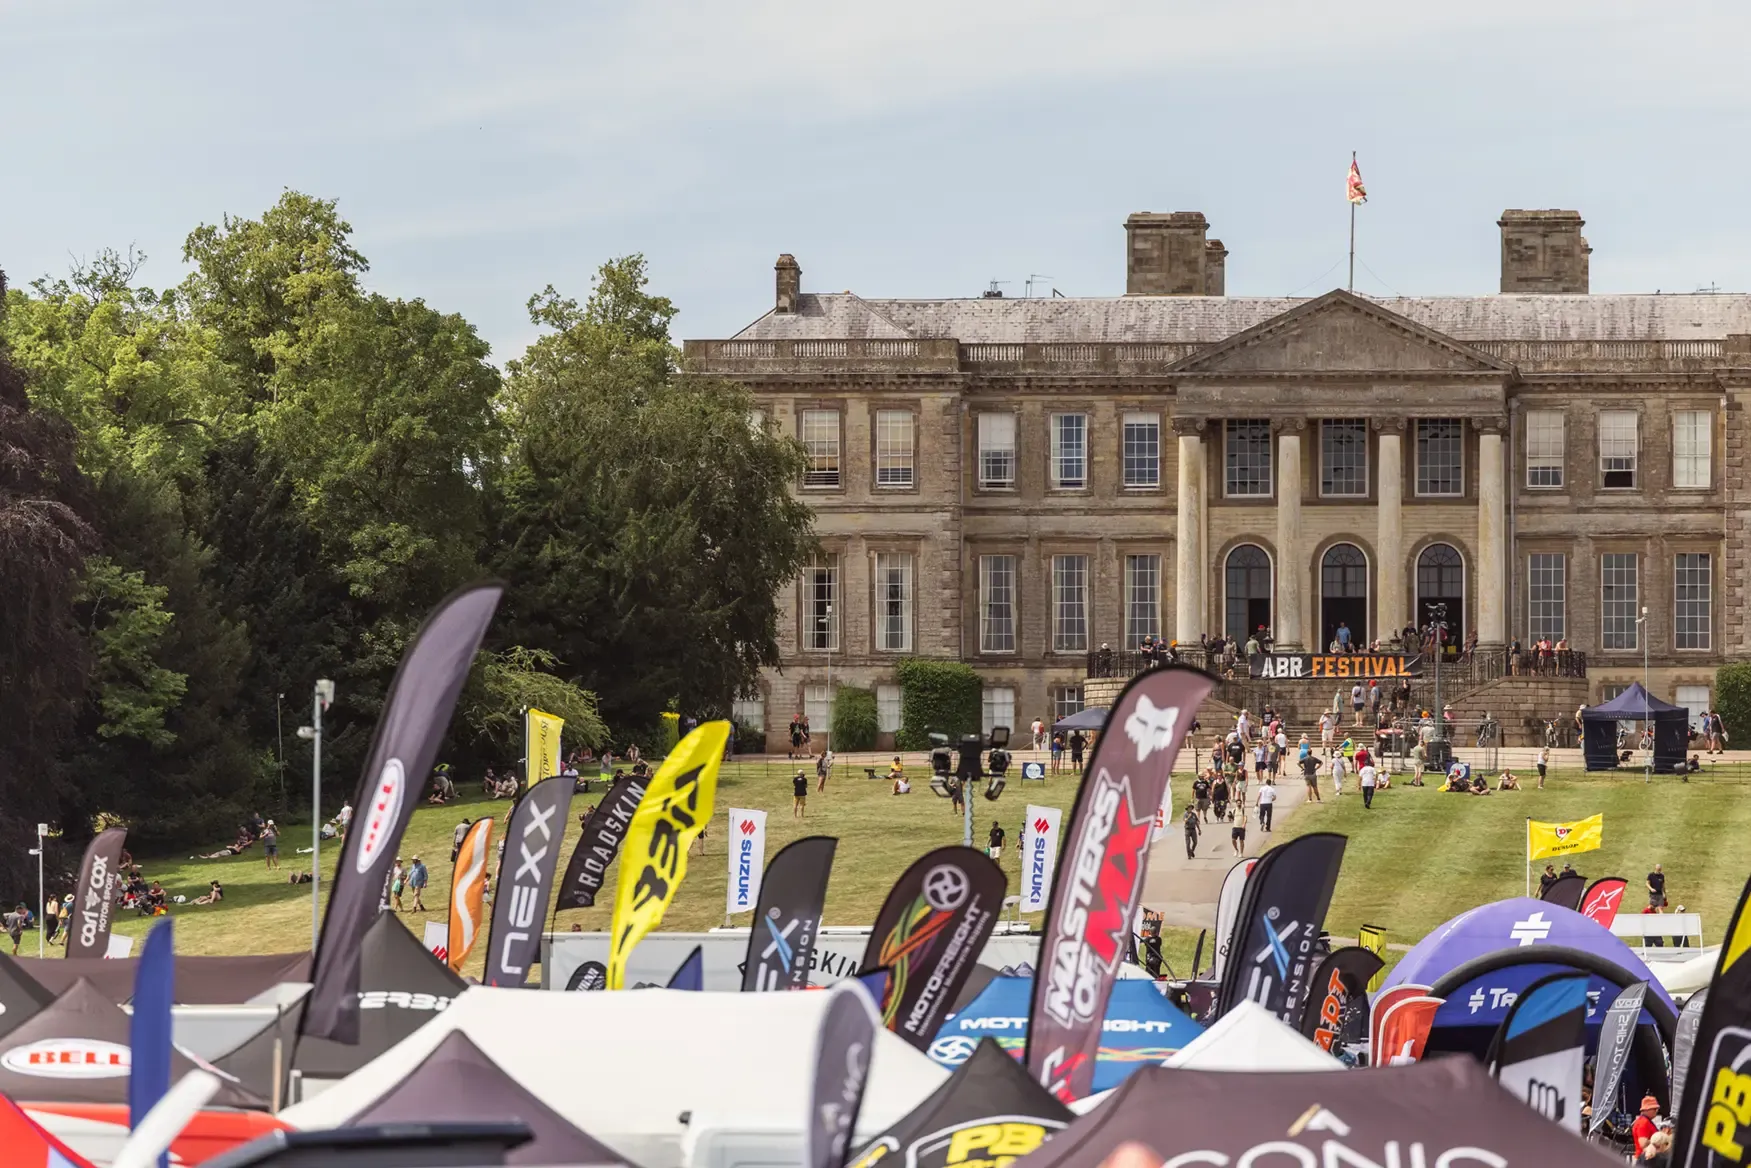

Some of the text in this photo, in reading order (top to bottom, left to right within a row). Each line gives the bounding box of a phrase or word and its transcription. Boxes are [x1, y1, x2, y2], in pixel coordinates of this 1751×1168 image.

[1262, 656, 1412, 678] ABR FESTIVAL
[578, 781, 646, 887] ROADSKIN
[1552, 843, 1579, 852] DUNLOP
[98, 872, 115, 932] MOTOR SPORT
[738, 839, 752, 905] SUZUKI
[1030, 837, 1045, 903] SUZUKI
[1051, 780, 1120, 1019] MASTERS
[1074, 794, 1151, 1017] OF MX
[904, 902, 981, 1033] MOTOFREIGHT
[946, 1123, 1046, 1164] PB
